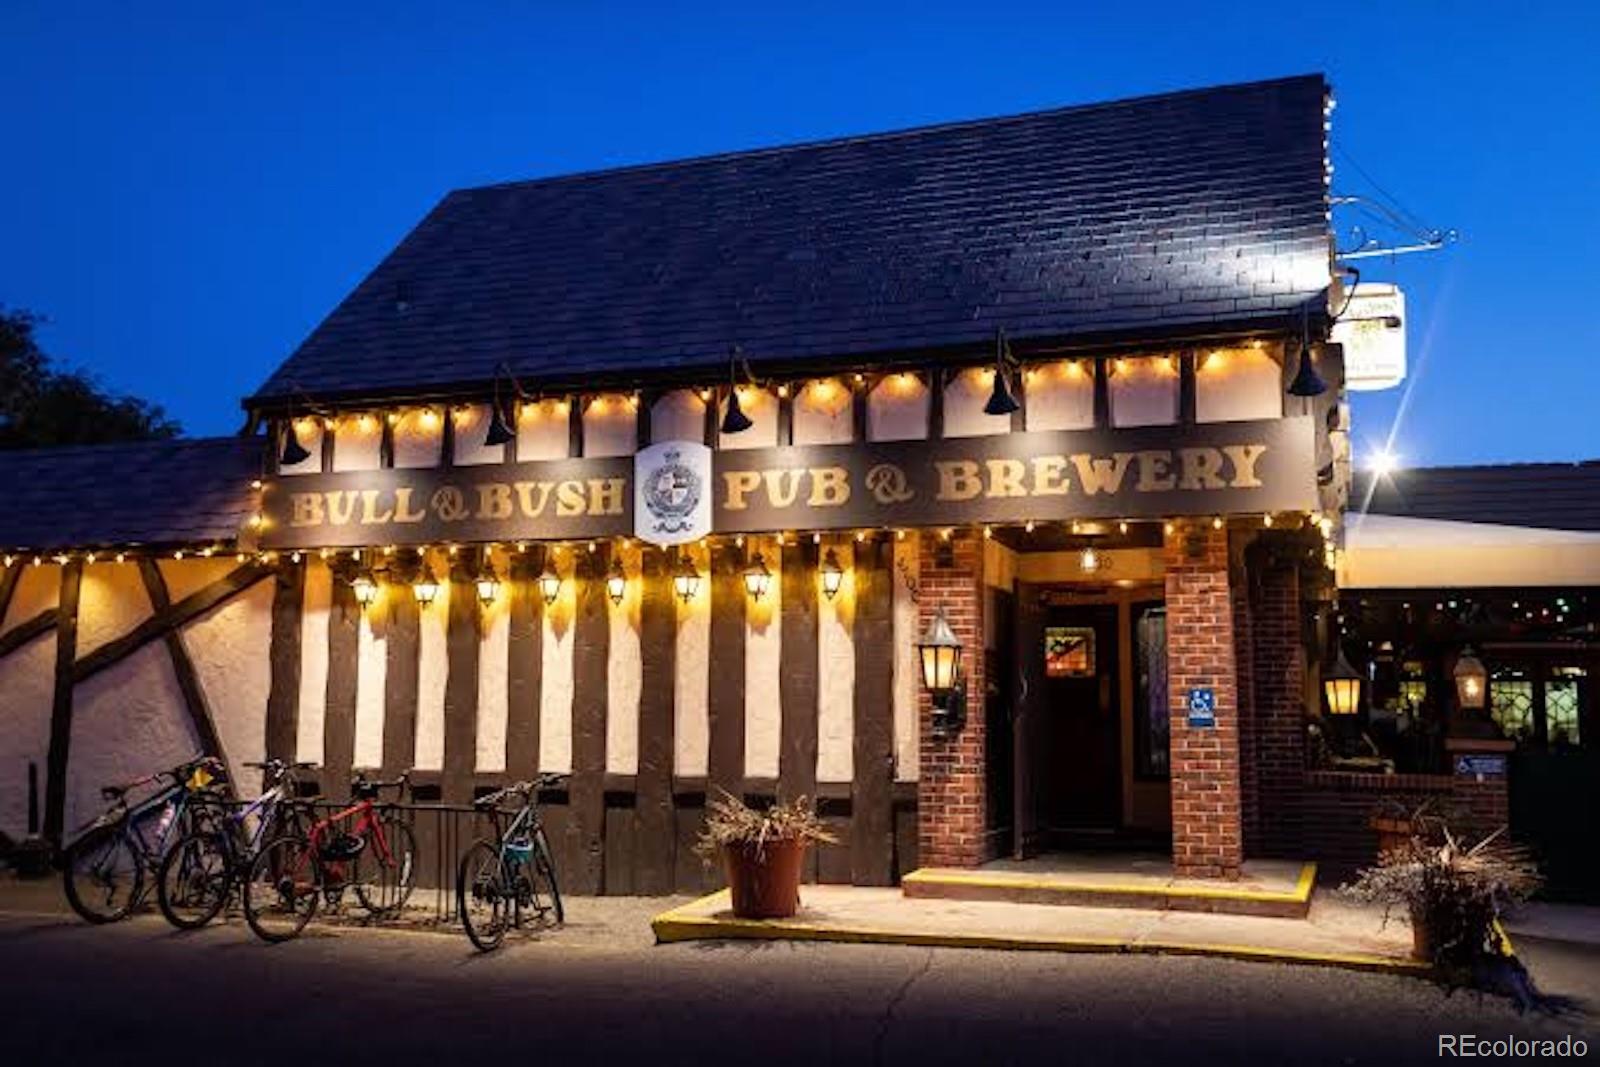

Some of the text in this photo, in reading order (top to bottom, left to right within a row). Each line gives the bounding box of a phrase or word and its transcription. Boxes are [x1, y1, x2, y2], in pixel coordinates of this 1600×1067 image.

[291, 478, 624, 528] BULL & BUSH
[722, 445, 1267, 511] PUB & BREWERY
